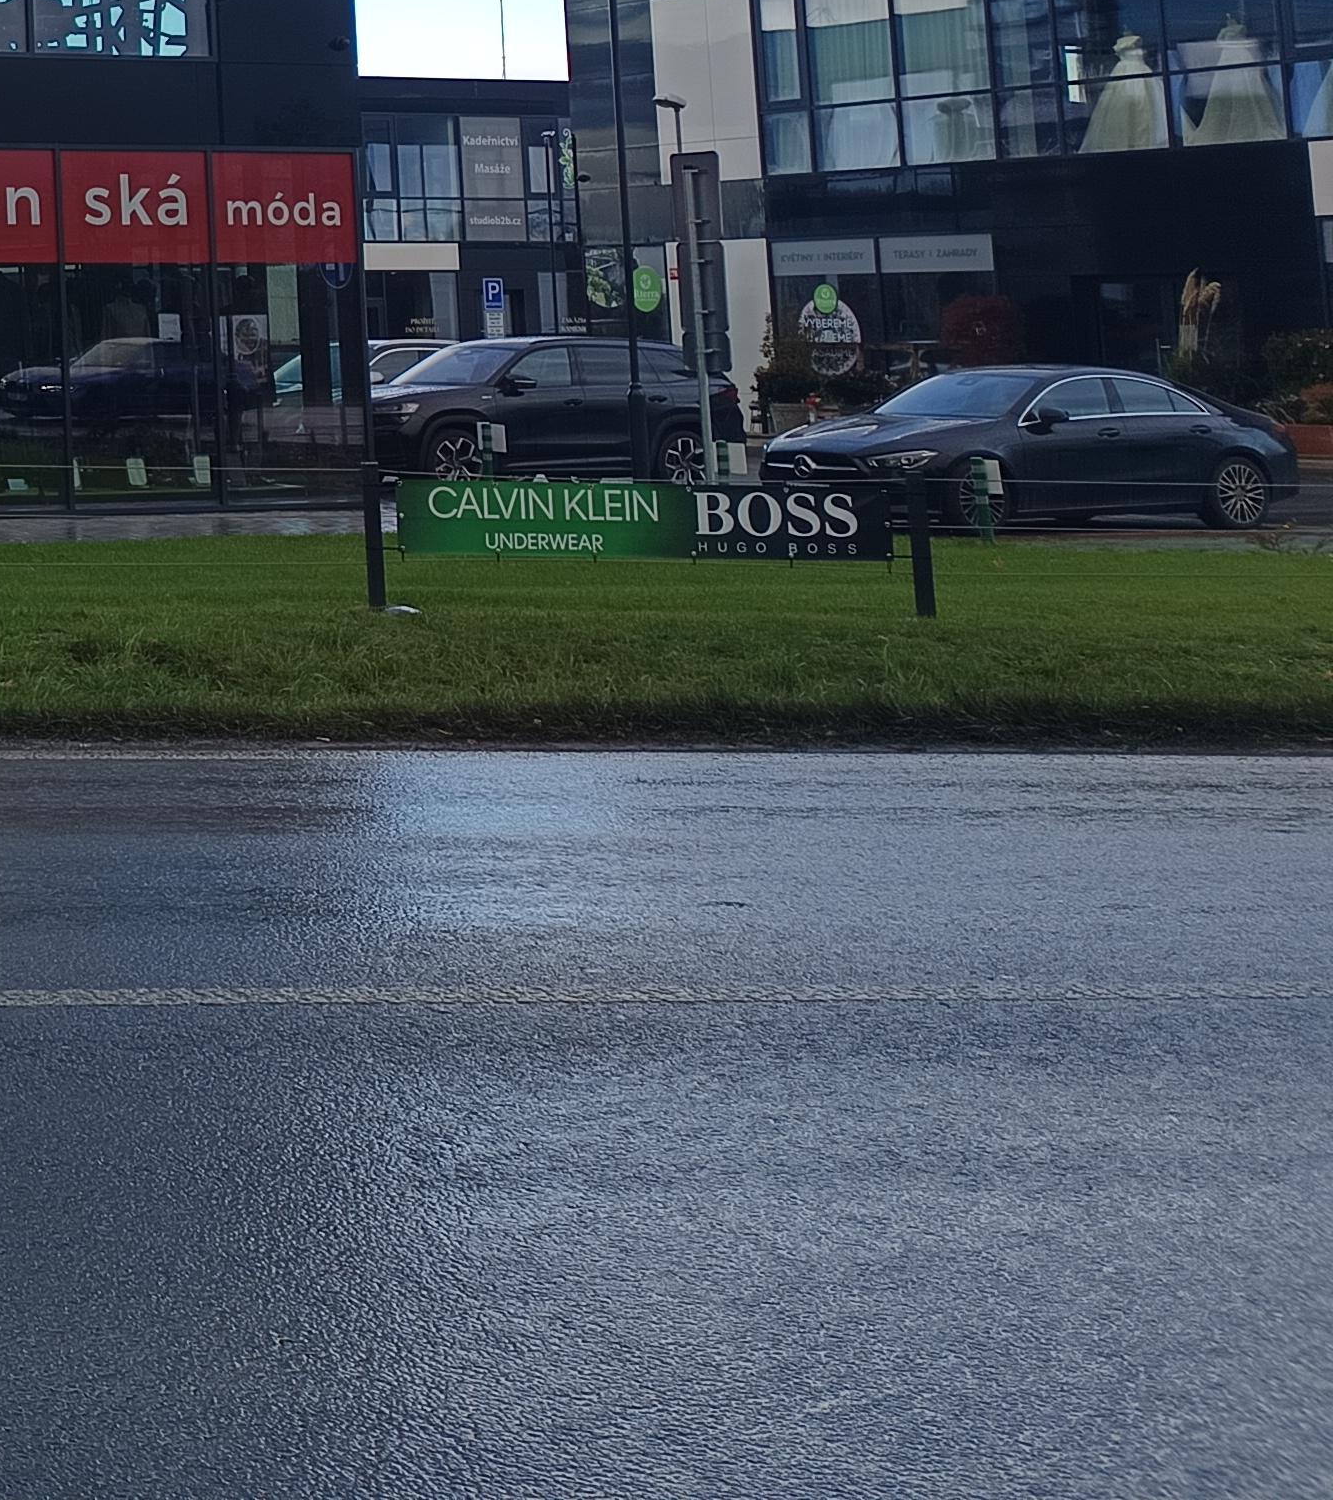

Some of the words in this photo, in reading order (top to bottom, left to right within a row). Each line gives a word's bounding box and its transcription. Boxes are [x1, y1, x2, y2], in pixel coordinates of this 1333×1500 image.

[462, 135, 518, 146] Kadeřnictví
[474, 163, 511, 174] Masáže
[84, 173, 188, 226] ská
[226, 192, 341, 226] móda
[469, 215, 522, 226] studiob2b.cz
[893, 249, 925, 259] TERASY
[936, 247, 978, 258] ZAHRADY
[488, 282, 500, 301] P
[428, 486, 554, 520] CALVIN
[564, 488, 659, 522] KLEIN
[693, 491, 858, 538] BOSS
[485, 532, 604, 551] UNDERWEAR
[698, 541, 767, 553] HUGO
[788, 542, 858, 555] BOSS
